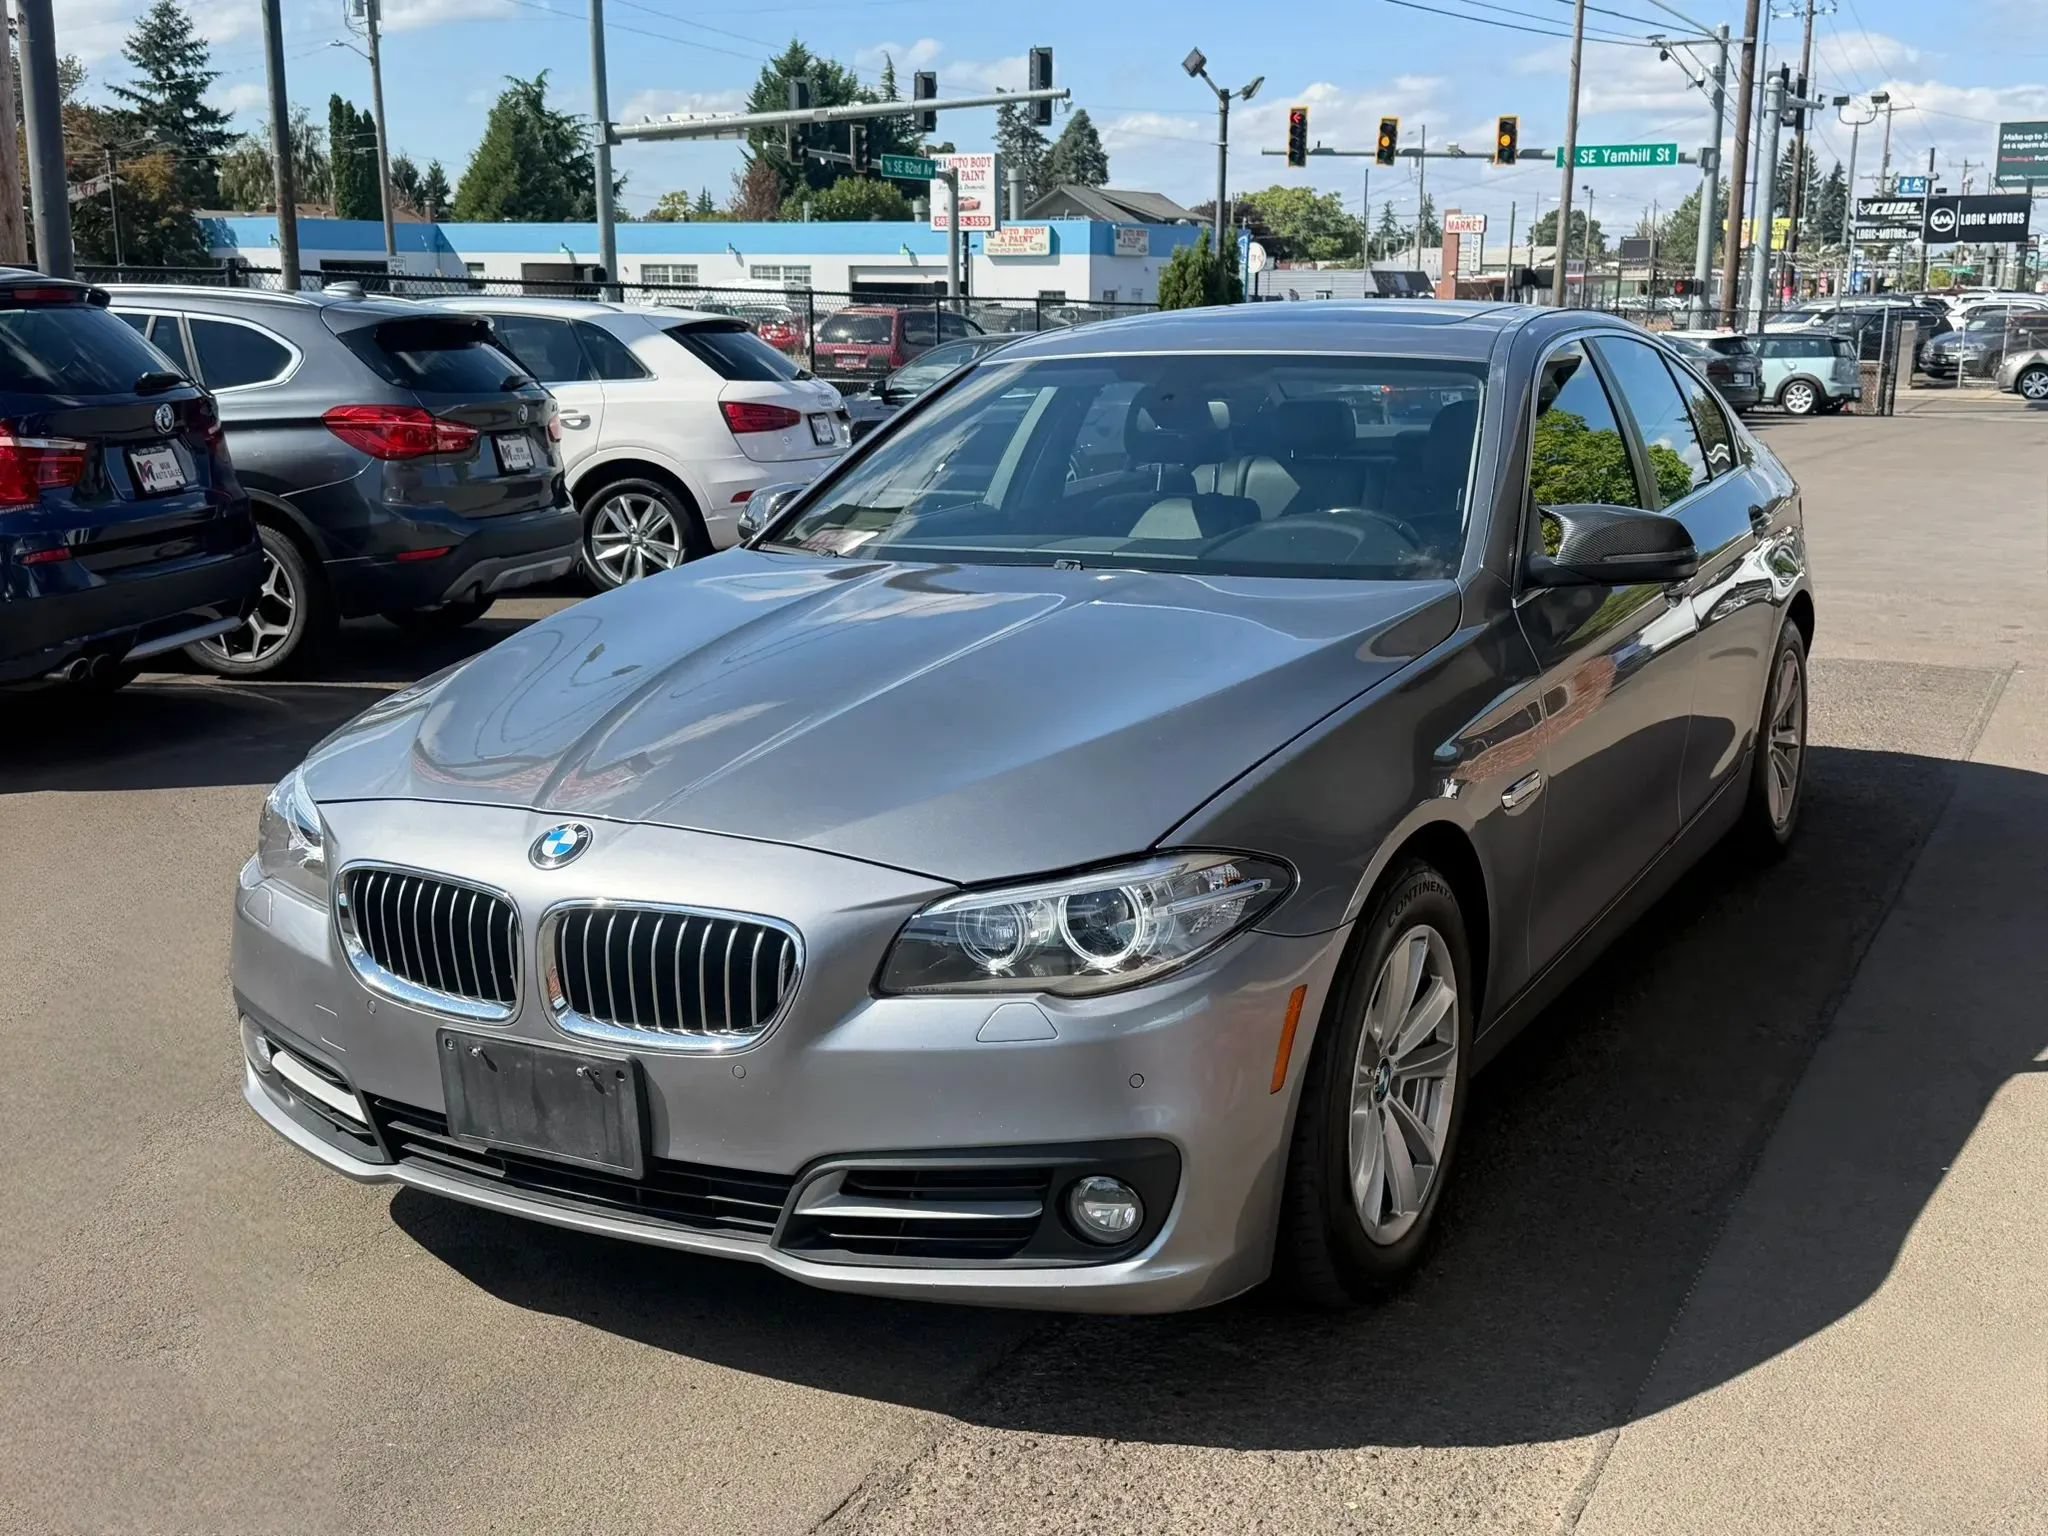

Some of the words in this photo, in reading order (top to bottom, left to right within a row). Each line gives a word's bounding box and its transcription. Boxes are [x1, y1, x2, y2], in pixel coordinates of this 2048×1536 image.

[970, 156, 992, 168] BODY
[1580, 149, 1597, 164] SE
[1602, 148, 1651, 163] Yamhill
[1656, 147, 1670, 162] St
[893, 160, 903, 173] SE
[961, 170, 985, 181] PAINT
[1869, 202, 1920, 215] CUDL
[1448, 220, 1483, 231] MARKET
[1960, 213, 1986, 226] LOGIC
[1988, 212, 2025, 225] MOTORS
[1387, 880, 1455, 928] CONTINENTA
